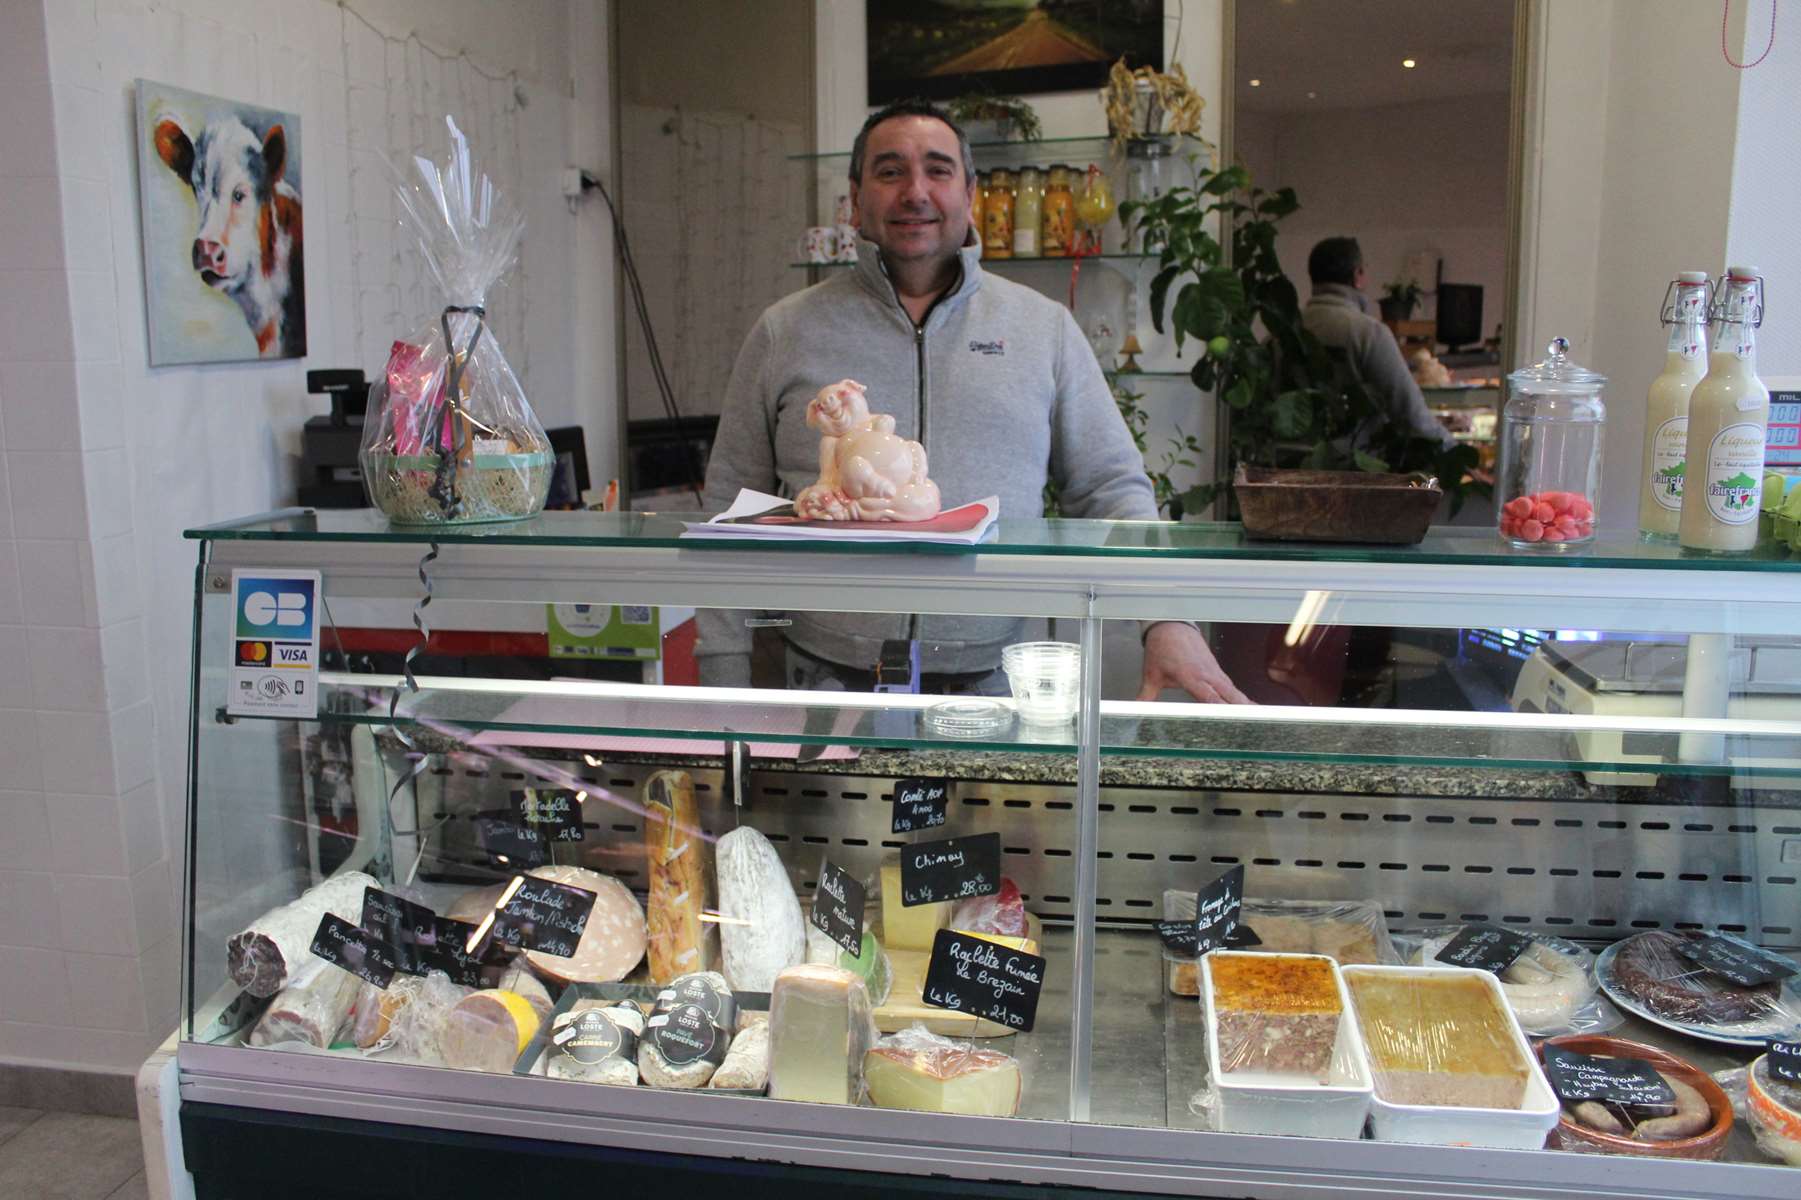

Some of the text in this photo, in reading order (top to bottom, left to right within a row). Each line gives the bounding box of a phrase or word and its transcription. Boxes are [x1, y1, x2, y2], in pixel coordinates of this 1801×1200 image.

[244, 591, 307, 627] CB
[280, 649, 308, 662] VISA
[914, 850, 965, 870] Chimay
[950, 942, 1000, 969] Raclette
